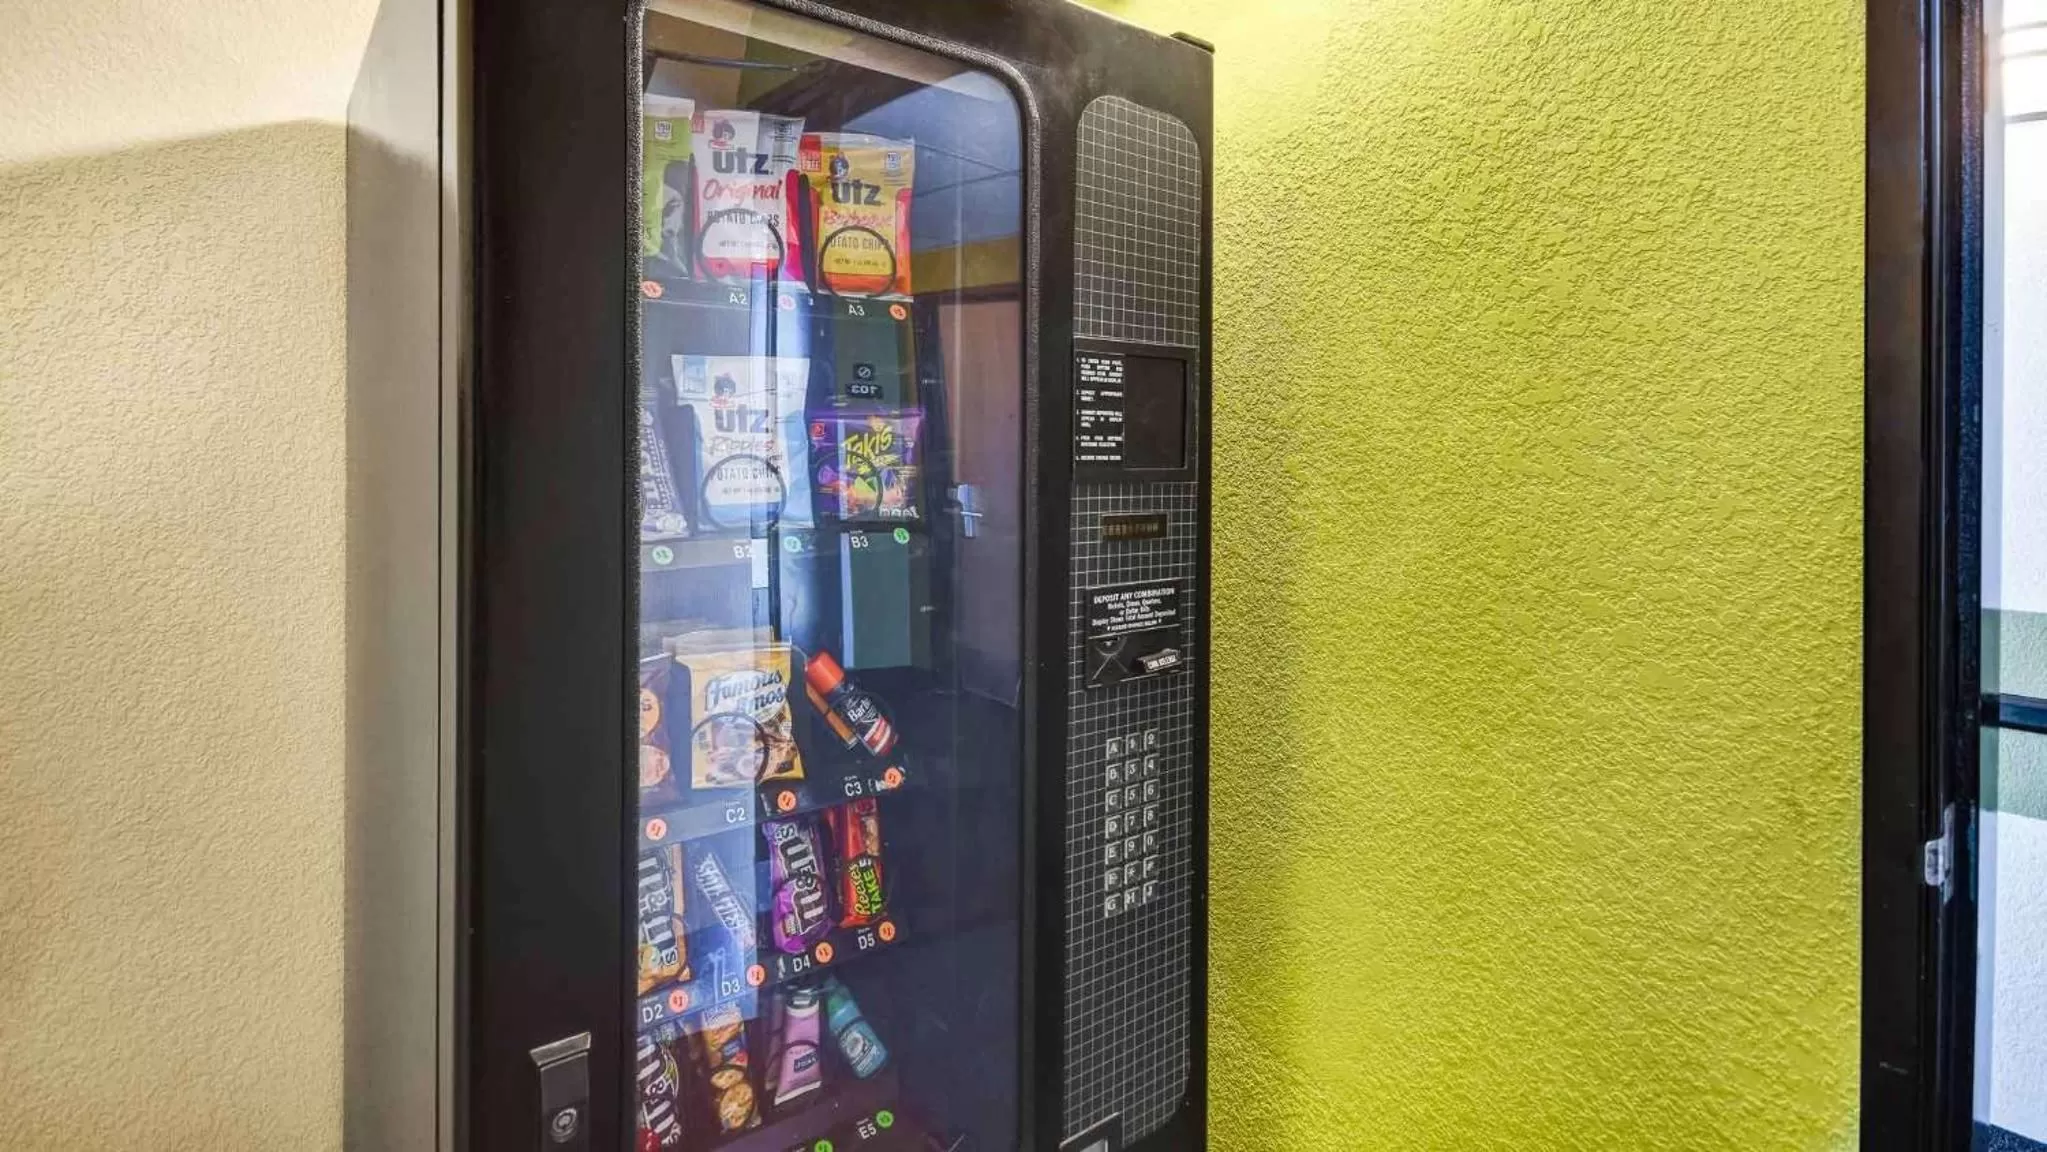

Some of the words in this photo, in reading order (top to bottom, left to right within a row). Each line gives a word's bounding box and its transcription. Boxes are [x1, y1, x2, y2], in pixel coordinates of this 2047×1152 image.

[703, 179, 782, 207] Original
[728, 292, 748, 305] A2
[848, 304, 865, 316] A3
[844, 425, 893, 460] Takis
[851, 535, 869, 548] B3
[711, 669, 783, 705] Famous
[845, 781, 862, 797] C3
[726, 807, 746, 824] C2
[863, 868, 882, 915] TAKE
[858, 933, 876, 950] D5
[793, 954, 811, 972] D4
[721, 978, 741, 997] D3
[642, 1003, 664, 1023] D2
[859, 1123, 877, 1139] E5
